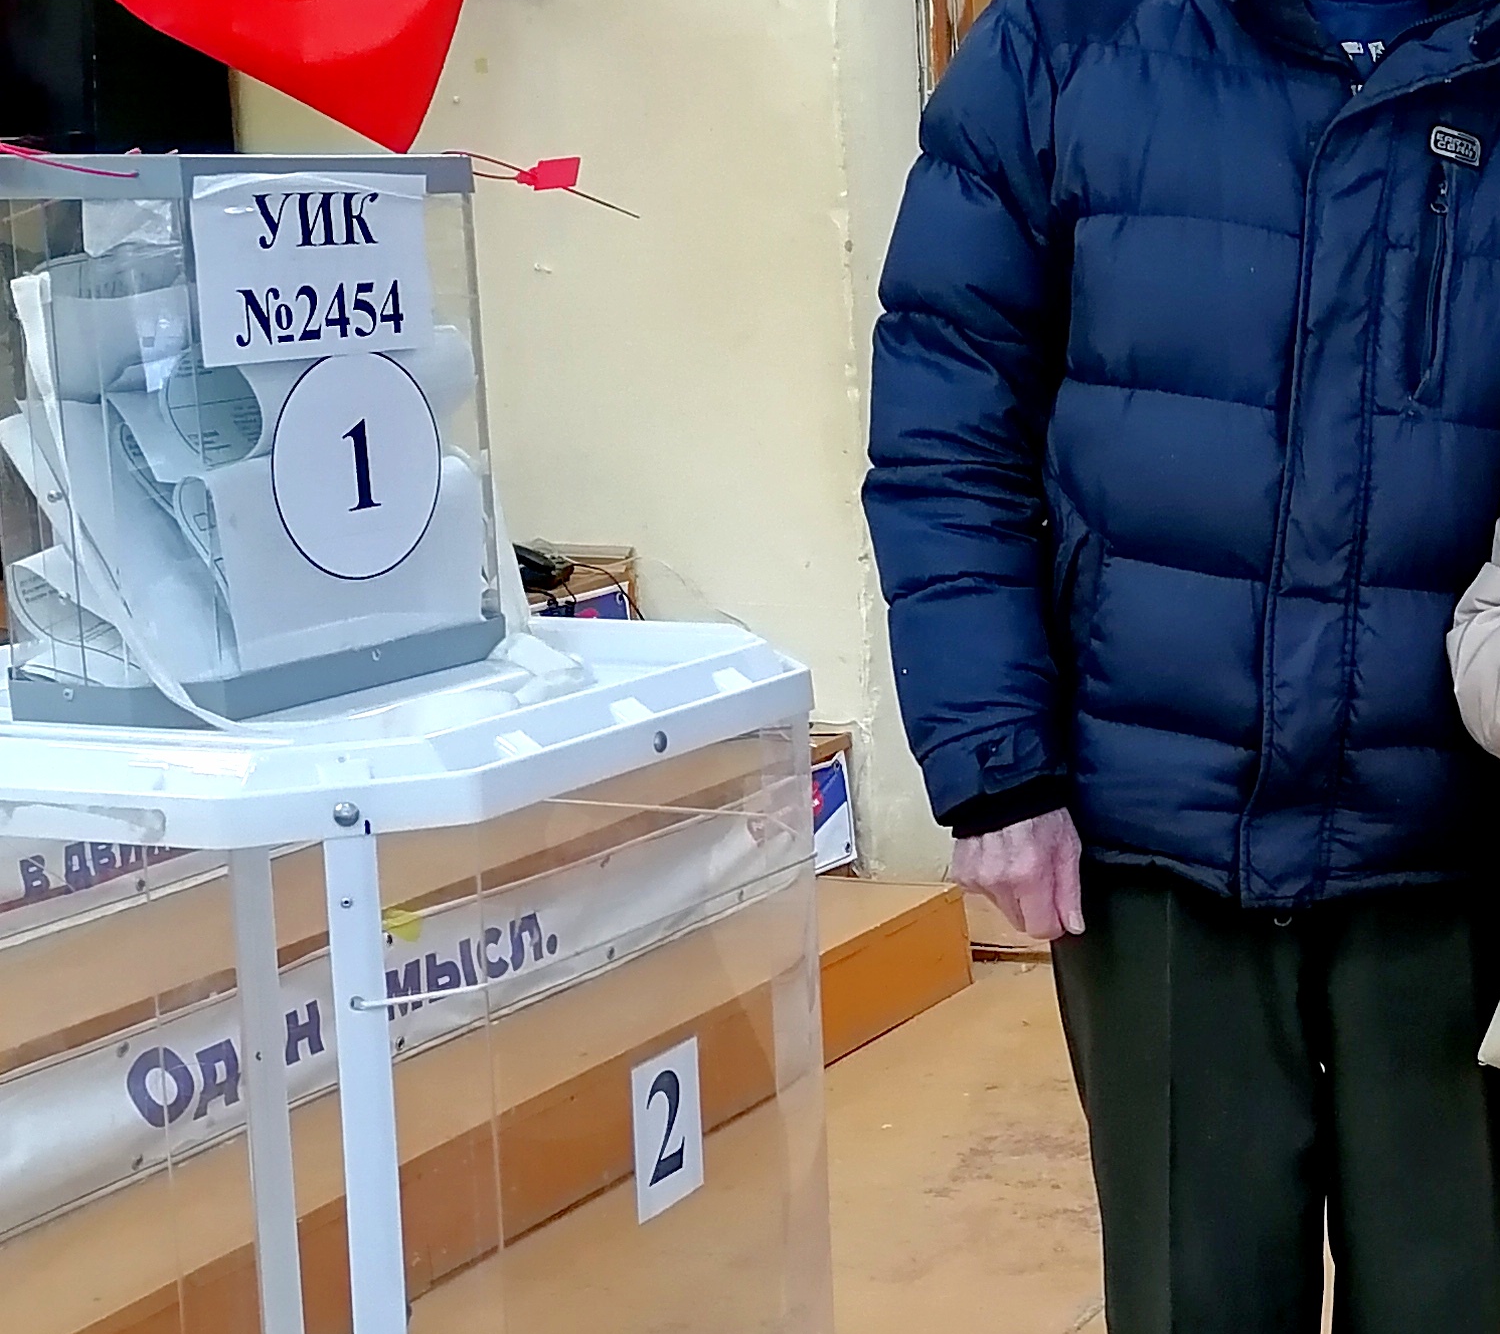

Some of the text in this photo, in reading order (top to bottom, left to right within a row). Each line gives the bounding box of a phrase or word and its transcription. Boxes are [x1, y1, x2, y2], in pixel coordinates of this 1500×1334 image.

[252, 191, 379, 249] УИК
[235, 279, 404, 348] №2454
[341, 418, 382, 512] 1
[126, 911, 558, 1129] Одн мысл.
[645, 1069, 686, 1188] 2
